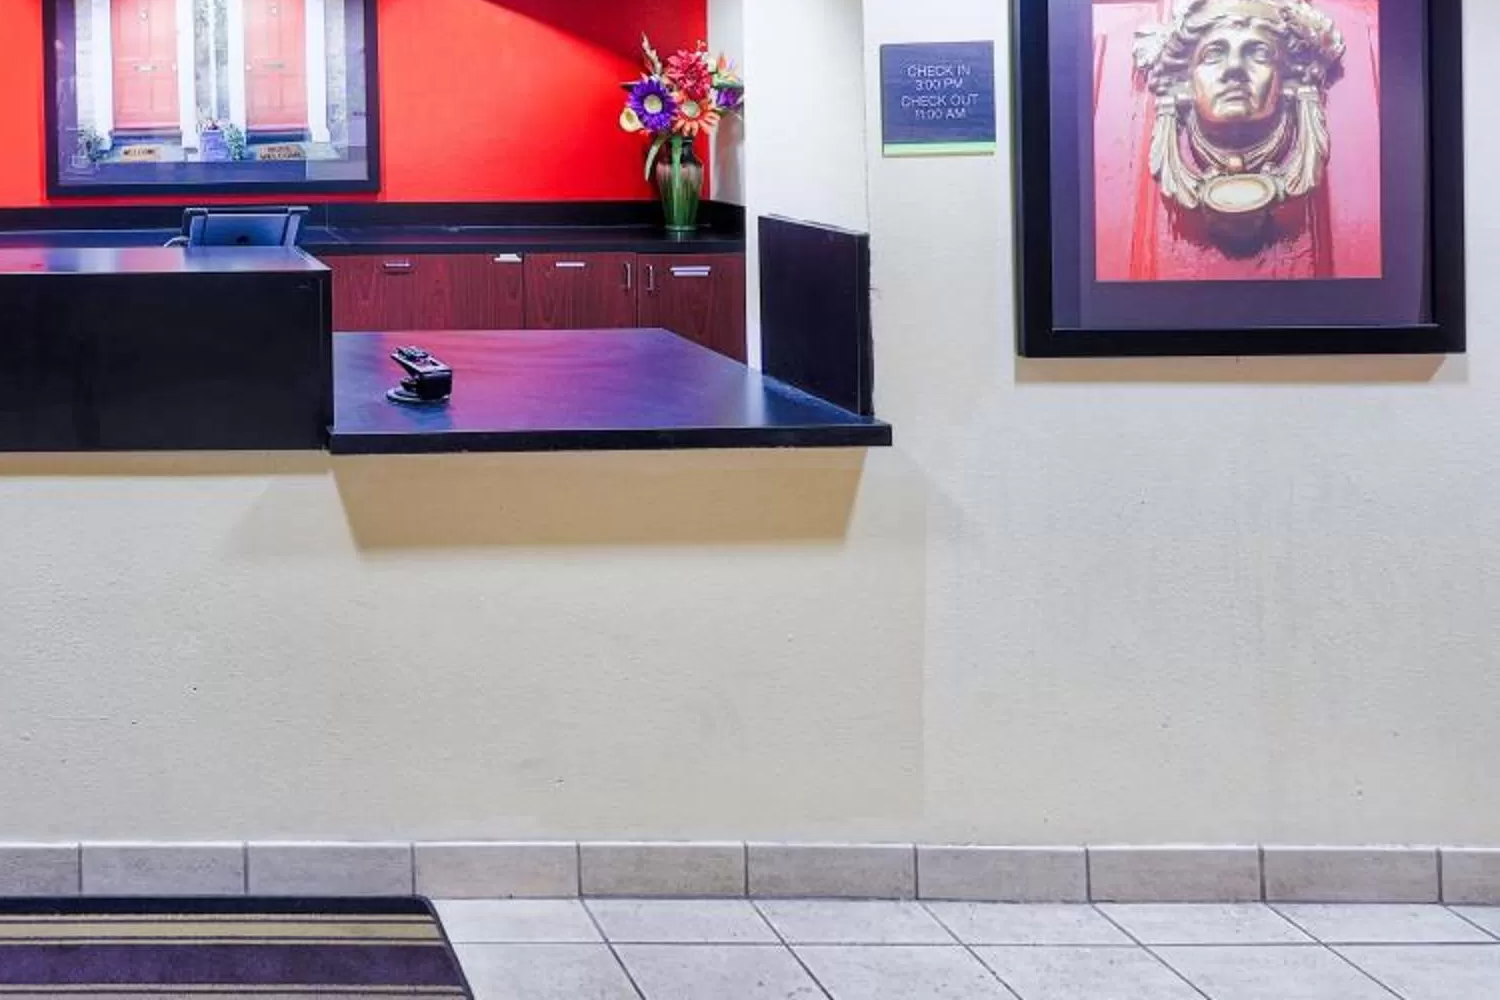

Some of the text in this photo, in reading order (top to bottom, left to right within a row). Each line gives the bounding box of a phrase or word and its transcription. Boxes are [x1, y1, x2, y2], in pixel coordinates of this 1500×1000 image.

[907, 64, 971, 78] CHECK IN
[943, 78, 963, 89] PM
[901, 93, 979, 108] CHECK OUT
[945, 108, 967, 120] AM
